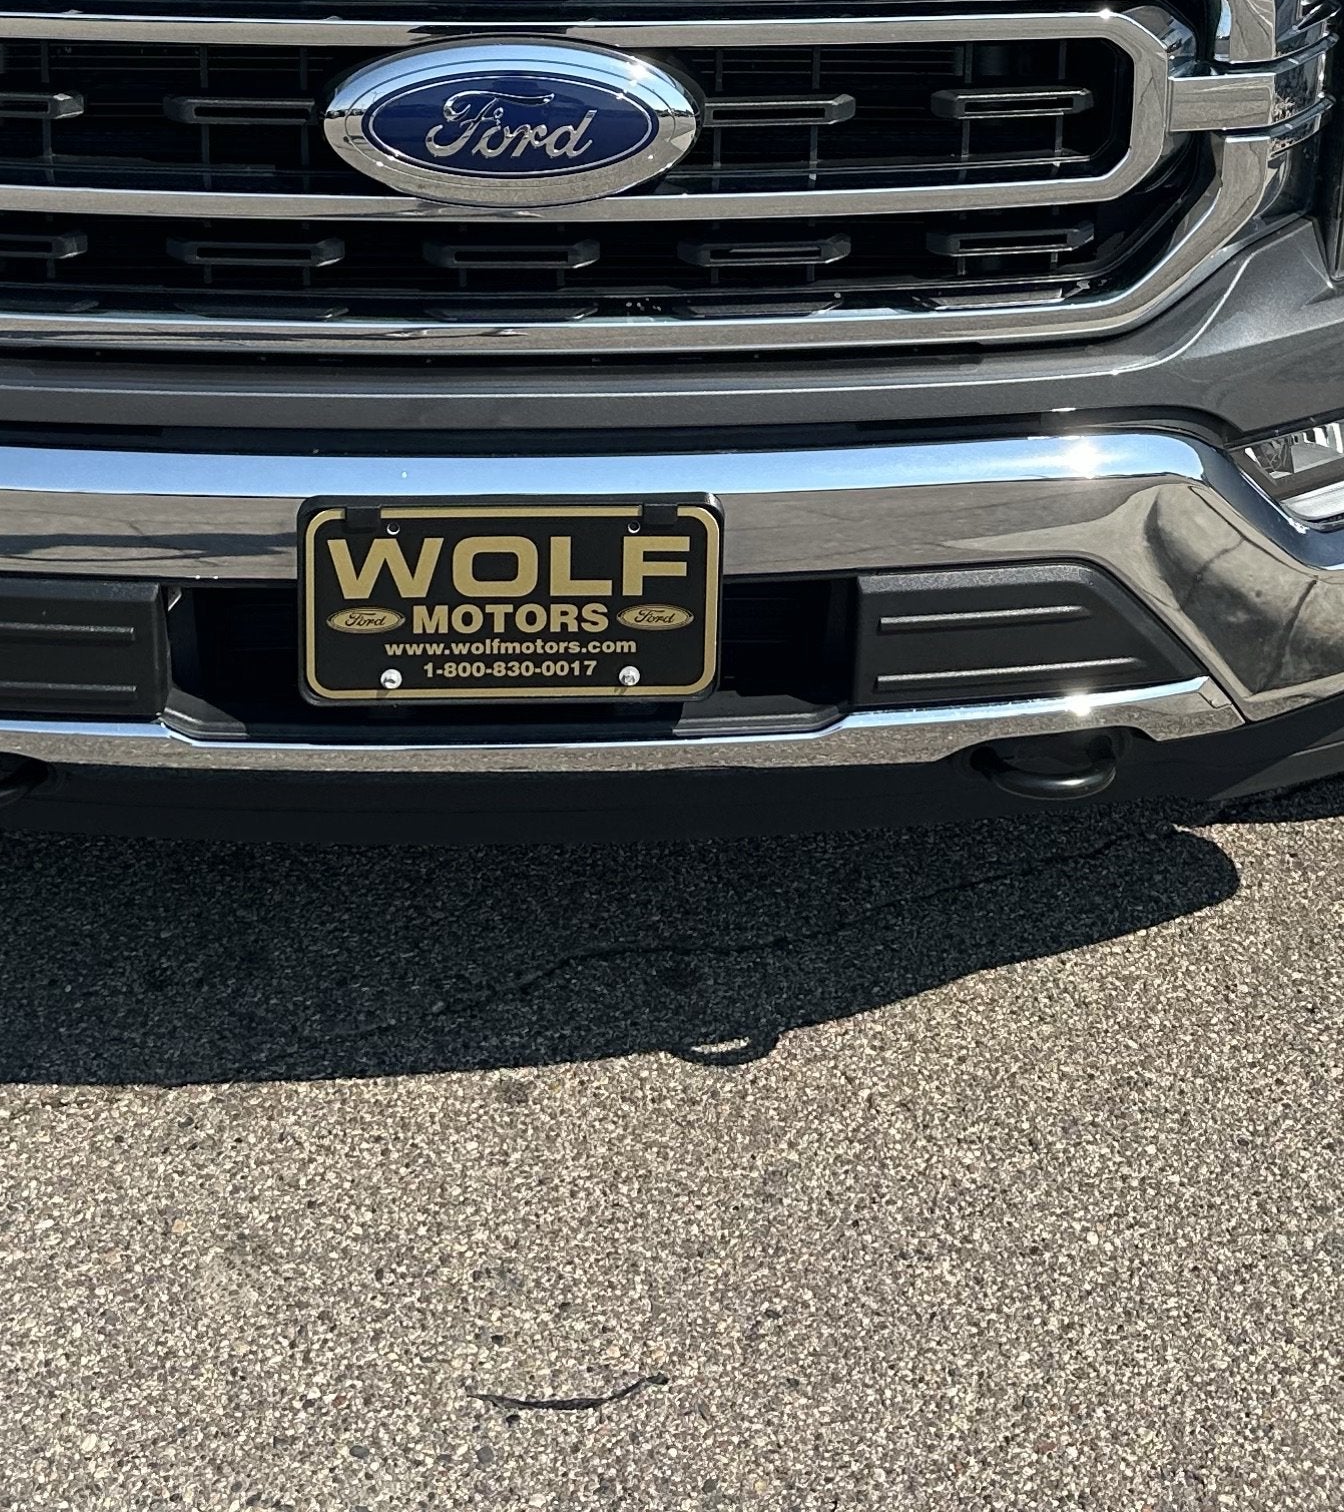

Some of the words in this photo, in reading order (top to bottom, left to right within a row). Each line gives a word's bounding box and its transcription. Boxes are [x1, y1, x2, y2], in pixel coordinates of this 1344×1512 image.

[424, 90, 598, 158] Ford
[326, 535, 691, 600] WOLF
[344, 612, 387, 627] Ford
[412, 603, 609, 634] MOTORS
[634, 609, 676, 624] Ford
[384, 638, 637, 656] www.wolfmotors.com
[423, 660, 597, 678] 1-800-830-0017
